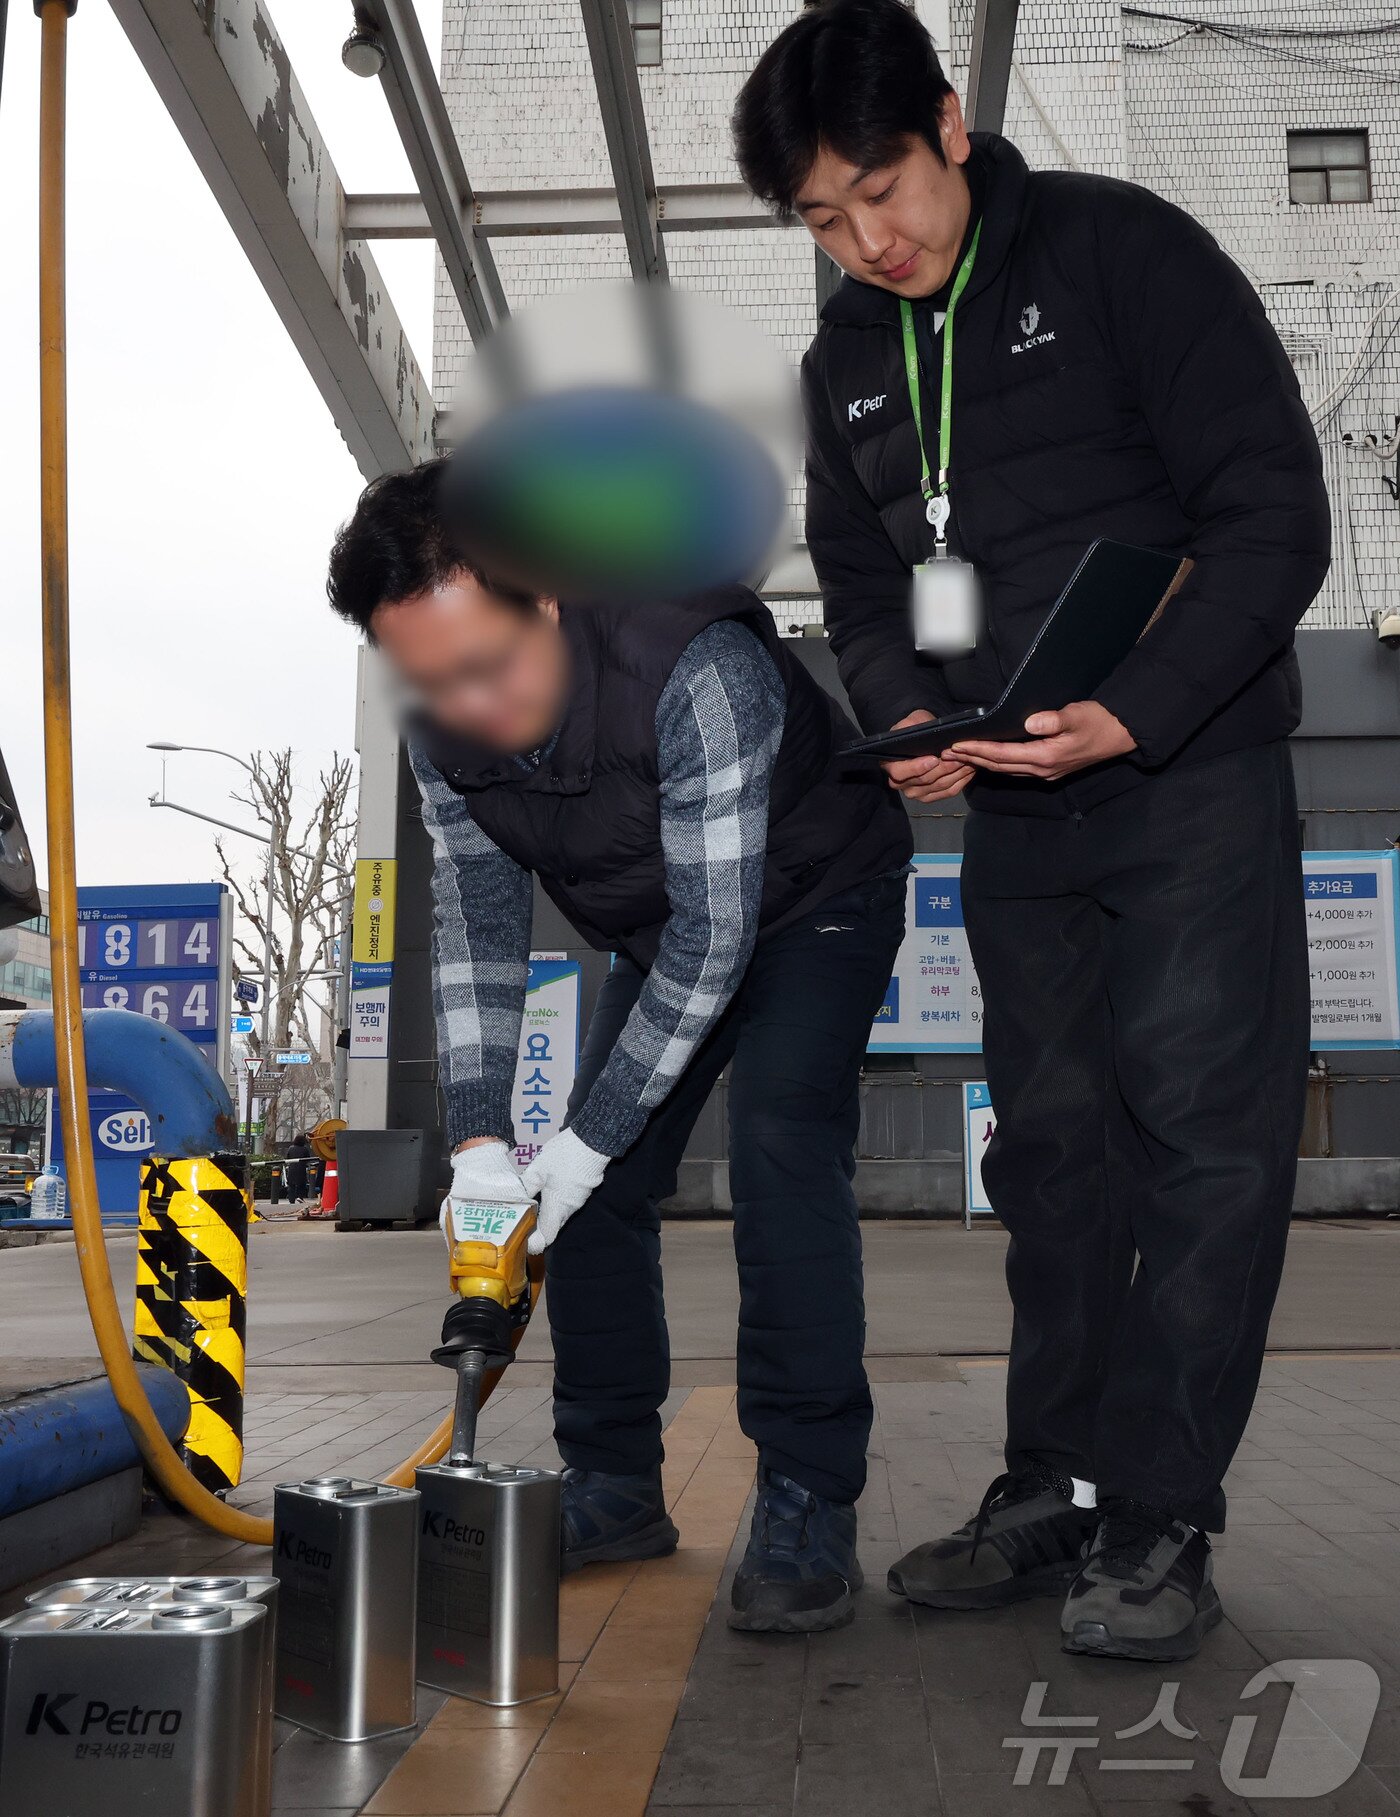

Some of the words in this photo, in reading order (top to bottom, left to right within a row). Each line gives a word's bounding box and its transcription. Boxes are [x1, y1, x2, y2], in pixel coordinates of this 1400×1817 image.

[848, 399, 862, 422] K
[371, 862, 382, 896] 주유중
[1307, 881, 1354, 894] 추가요금
[928, 896, 952, 910] 구분
[1307, 909, 1354, 921] +4,000원
[1356, 910, 1373, 918] 추가
[368, 914, 381, 960] 엔진정지
[930, 934, 950, 946] 기본
[1308, 940, 1355, 952] +2,000원
[1358, 940, 1374, 949] 추가
[920, 966, 960, 976] 유리막코팅
[1309, 970, 1357, 982] +1,000원
[1359, 971, 1375, 980] 추가
[930, 985, 951, 996] 하부
[355, 1002, 386, 1014] 보행자
[1325, 998, 1374, 1008] 부탁드립니다.
[360, 1016, 380, 1028] 주의
[920, 1010, 961, 1022] 왕복세차
[971, 1011, 985, 1023] 9,
[1311, 1013, 1359, 1023] 발행일로부터
[1362, 1012, 1382, 1023] 1개월
[521, 1033, 553, 1135] 요소수
[455, 1206, 517, 1220] 챙기셨나요?
[462, 1216, 505, 1235] 카드
[422, 1510, 443, 1538] K
[443, 1519, 486, 1546] Petro
[278, 1530, 295, 1561] K
[294, 1540, 332, 1570] Petro
[25, 1693, 80, 1736] K
[80, 1701, 183, 1736] Petro
[75, 1742, 176, 1760] 한국석유관리원
